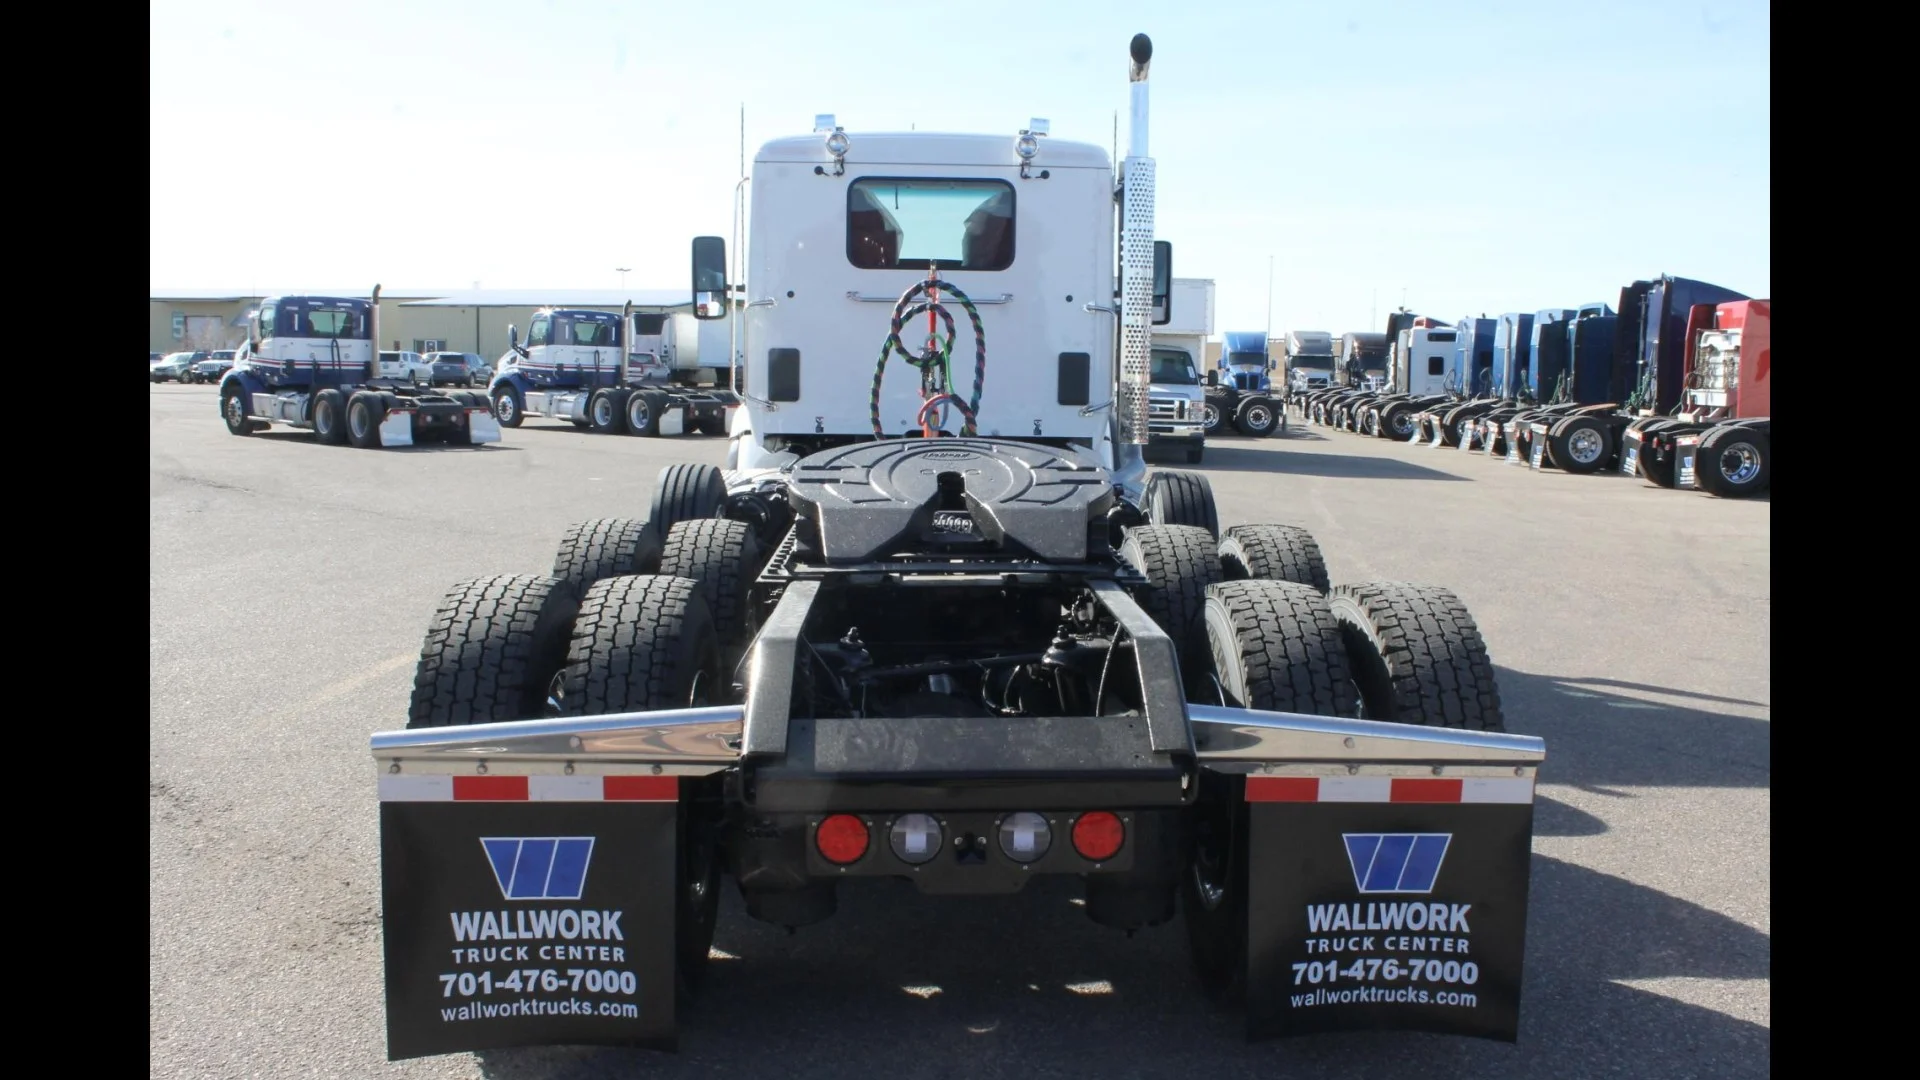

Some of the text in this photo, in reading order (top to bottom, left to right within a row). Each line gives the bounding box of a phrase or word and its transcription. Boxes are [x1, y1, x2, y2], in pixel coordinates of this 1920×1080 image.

[172, 316, 184, 338] 5
[450, 909, 624, 941] WALLWORK
[1307, 902, 1471, 932] WALLWORK
[452, 945, 625, 964] TRUCK CENTER
[1306, 937, 1469, 953] TRUCK CENTER
[439, 969, 636, 997] 701-476-7000
[1292, 959, 1479, 985] 701-476-7000
[1291, 986, 1477, 1007] wallworktrucks.com
[441, 998, 638, 1022] wallworktrucks.com
